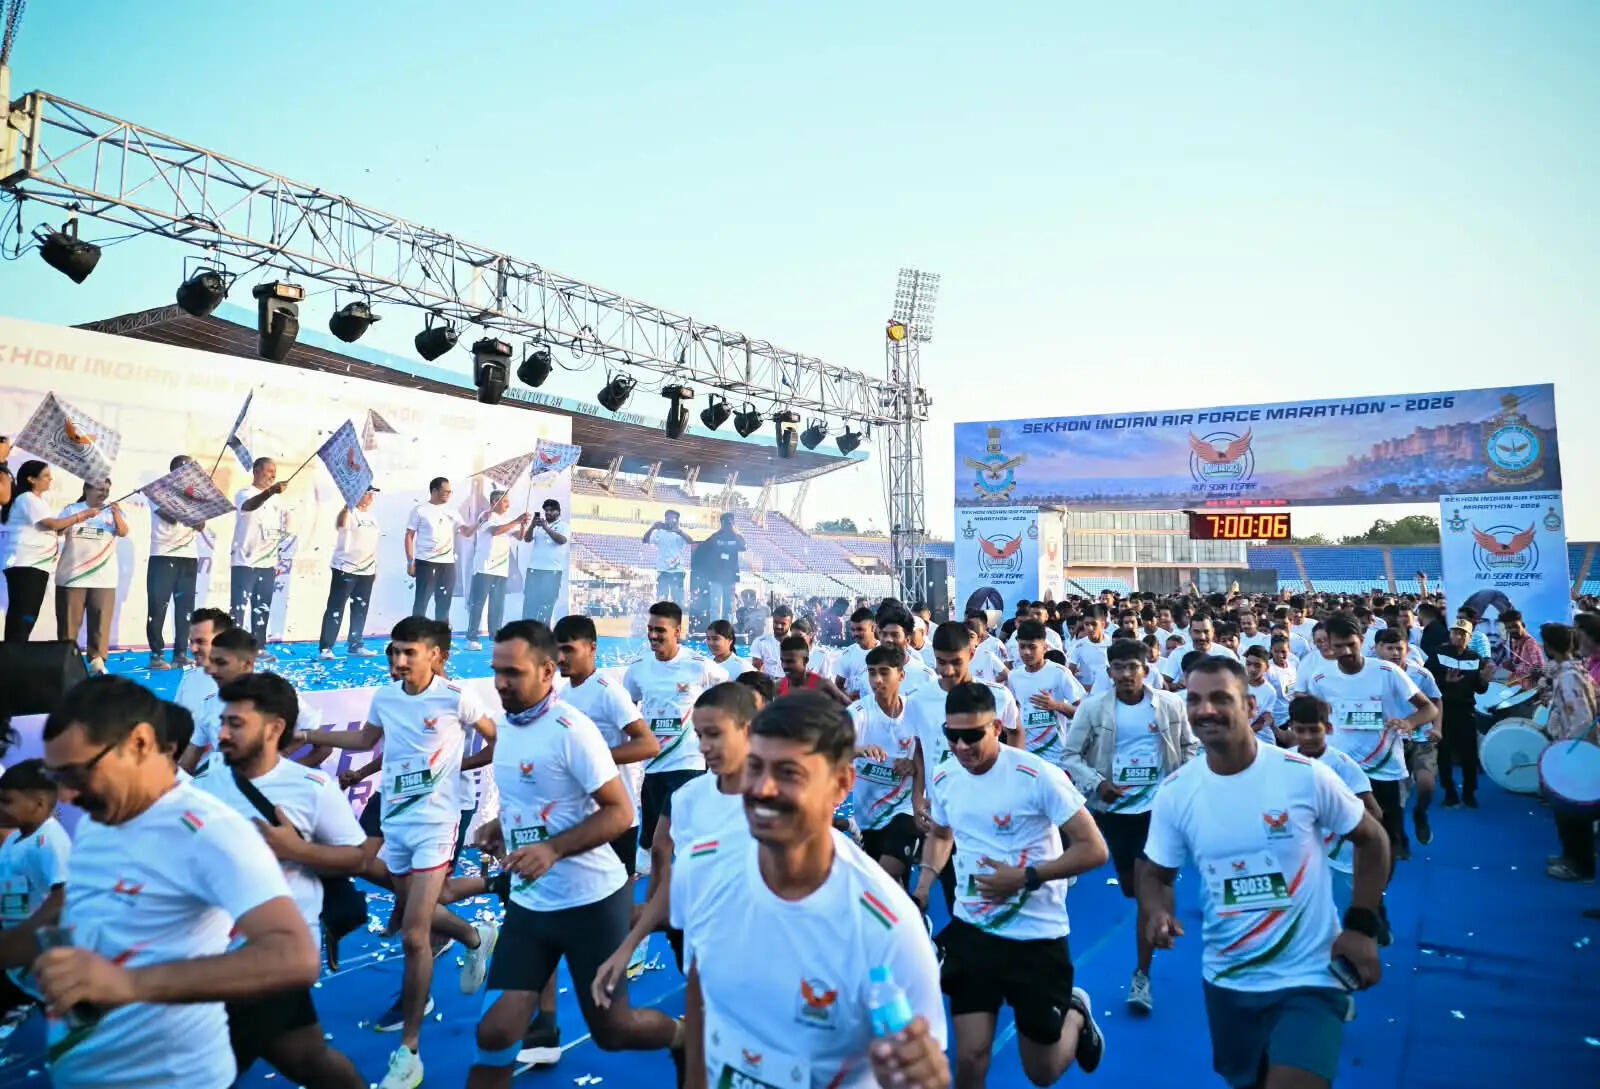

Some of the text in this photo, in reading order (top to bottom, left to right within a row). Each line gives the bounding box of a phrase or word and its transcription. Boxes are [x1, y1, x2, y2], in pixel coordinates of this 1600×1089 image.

[1022, 420, 1091, 434] SEKHON
[1095, 416, 1157, 430] INDIAN
[1162, 413, 1193, 426] AIR
[1198, 409, 1261, 424] FORCE
[1266, 401, 1386, 420] MARATHON
[1405, 396, 1456, 411] 2026
[1206, 515, 1289, 538] 7:00:06
[1475, 572, 1543, 580] RUN SOAR INSPIRE
[1231, 876, 1272, 896] 50033
